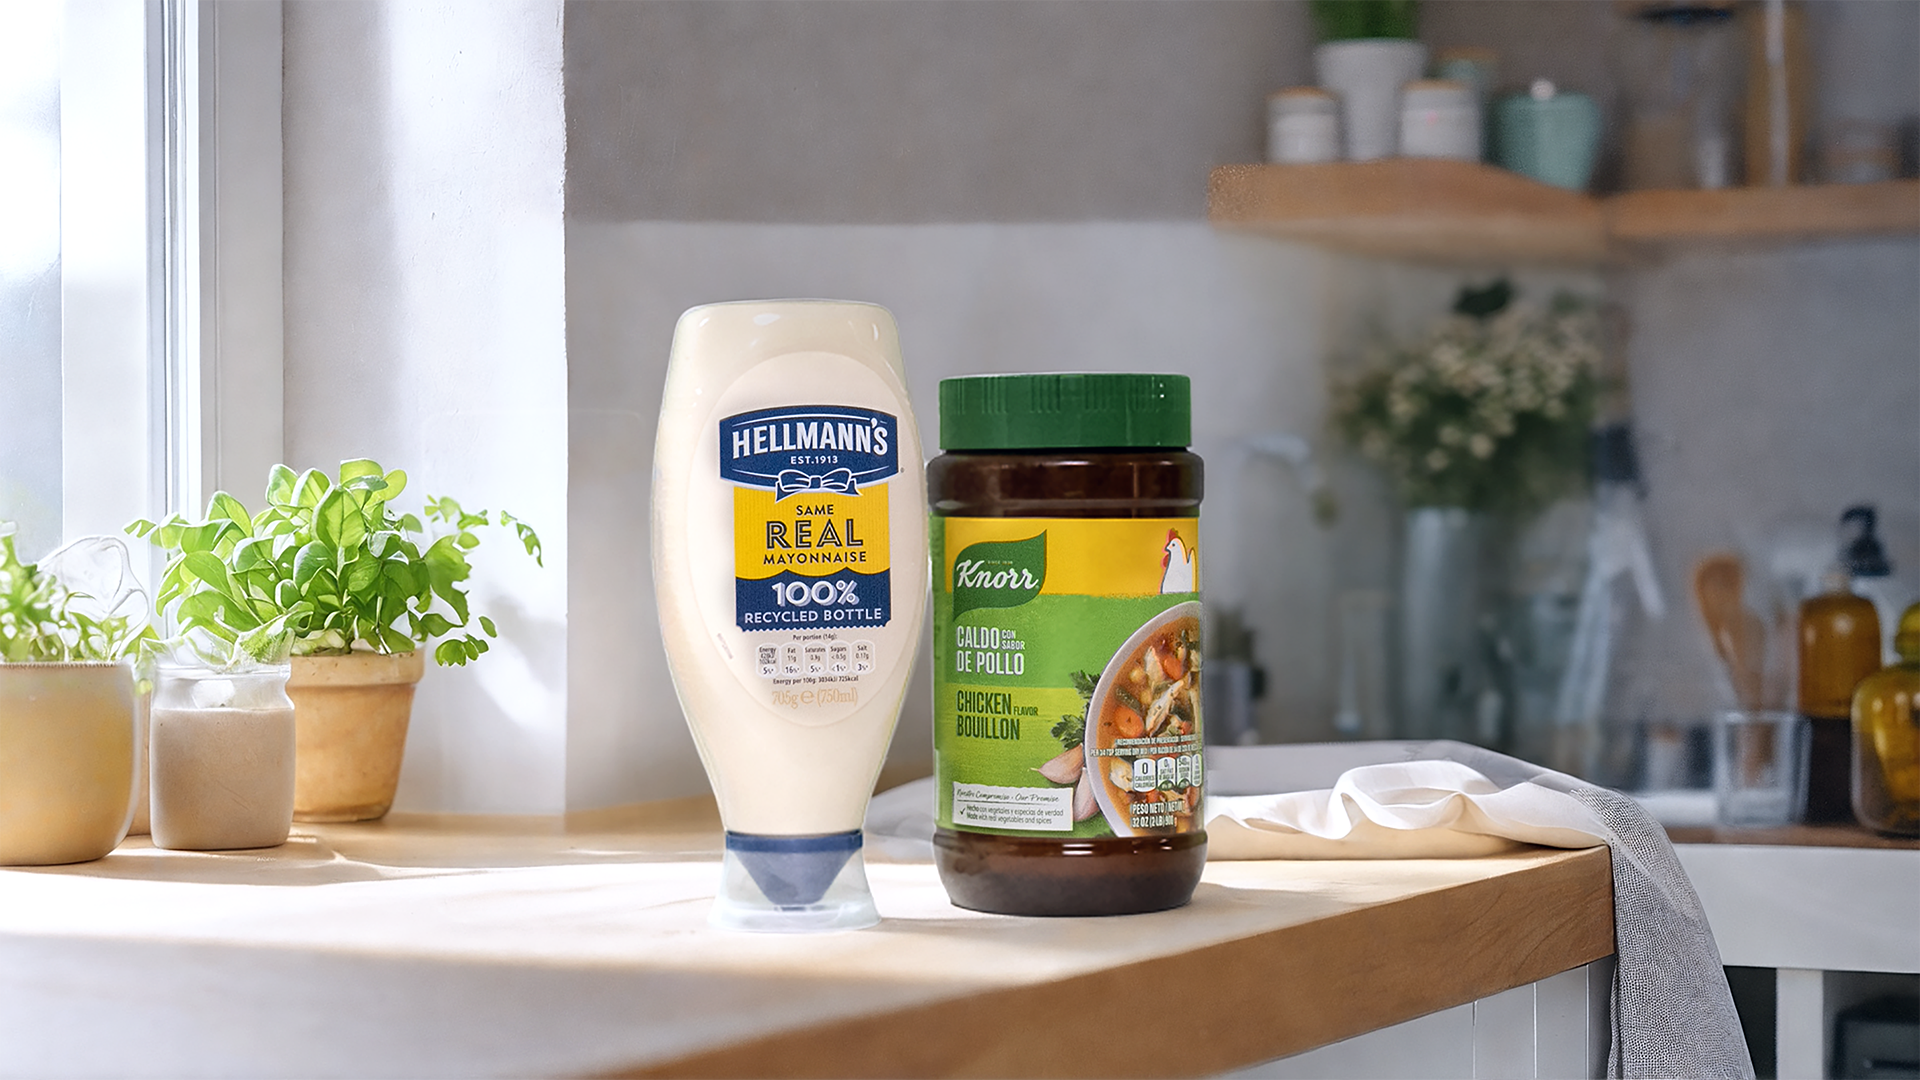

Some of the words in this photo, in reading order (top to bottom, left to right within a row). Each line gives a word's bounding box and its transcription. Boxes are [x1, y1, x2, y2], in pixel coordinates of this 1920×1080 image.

[732, 417, 889, 460] HELLMANN'S
[790, 456, 838, 465] EST.1913
[796, 504, 835, 516] SAME
[766, 518, 864, 550] REAL
[763, 551, 867, 565] MAYONNAISE
[956, 559, 1039, 590] Knorr
[771, 580, 860, 607] 100%
[744, 610, 819, 624] RECYCLED
[823, 608, 882, 622] BOTTLE
[802, 633, 822, 641] portion
[957, 625, 1000, 650] CALDO
[1001, 629, 1017, 640] CON
[1001, 640, 1026, 651] SABOR
[957, 650, 972, 673] DE
[976, 651, 1025, 675] POLLO
[771, 689, 798, 709] 705g
[816, 686, 859, 708] (750ml)
[956, 690, 1012, 715] CHICKEN
[1013, 706, 1038, 716] FLAVOR
[956, 715, 1020, 740] BOUILLON
[1142, 762, 1149, 775] 0
[1014, 792, 1029, 801] Our
[1029, 793, 1060, 803] Promise
[1014, 808, 1036, 816] especias
[1036, 808, 1044, 816] de
[1045, 809, 1064, 817] verdad
[1132, 802, 1149, 815] PESO
[1036, 816, 1052, 825] spices
[1140, 815, 1149, 828] OZ
